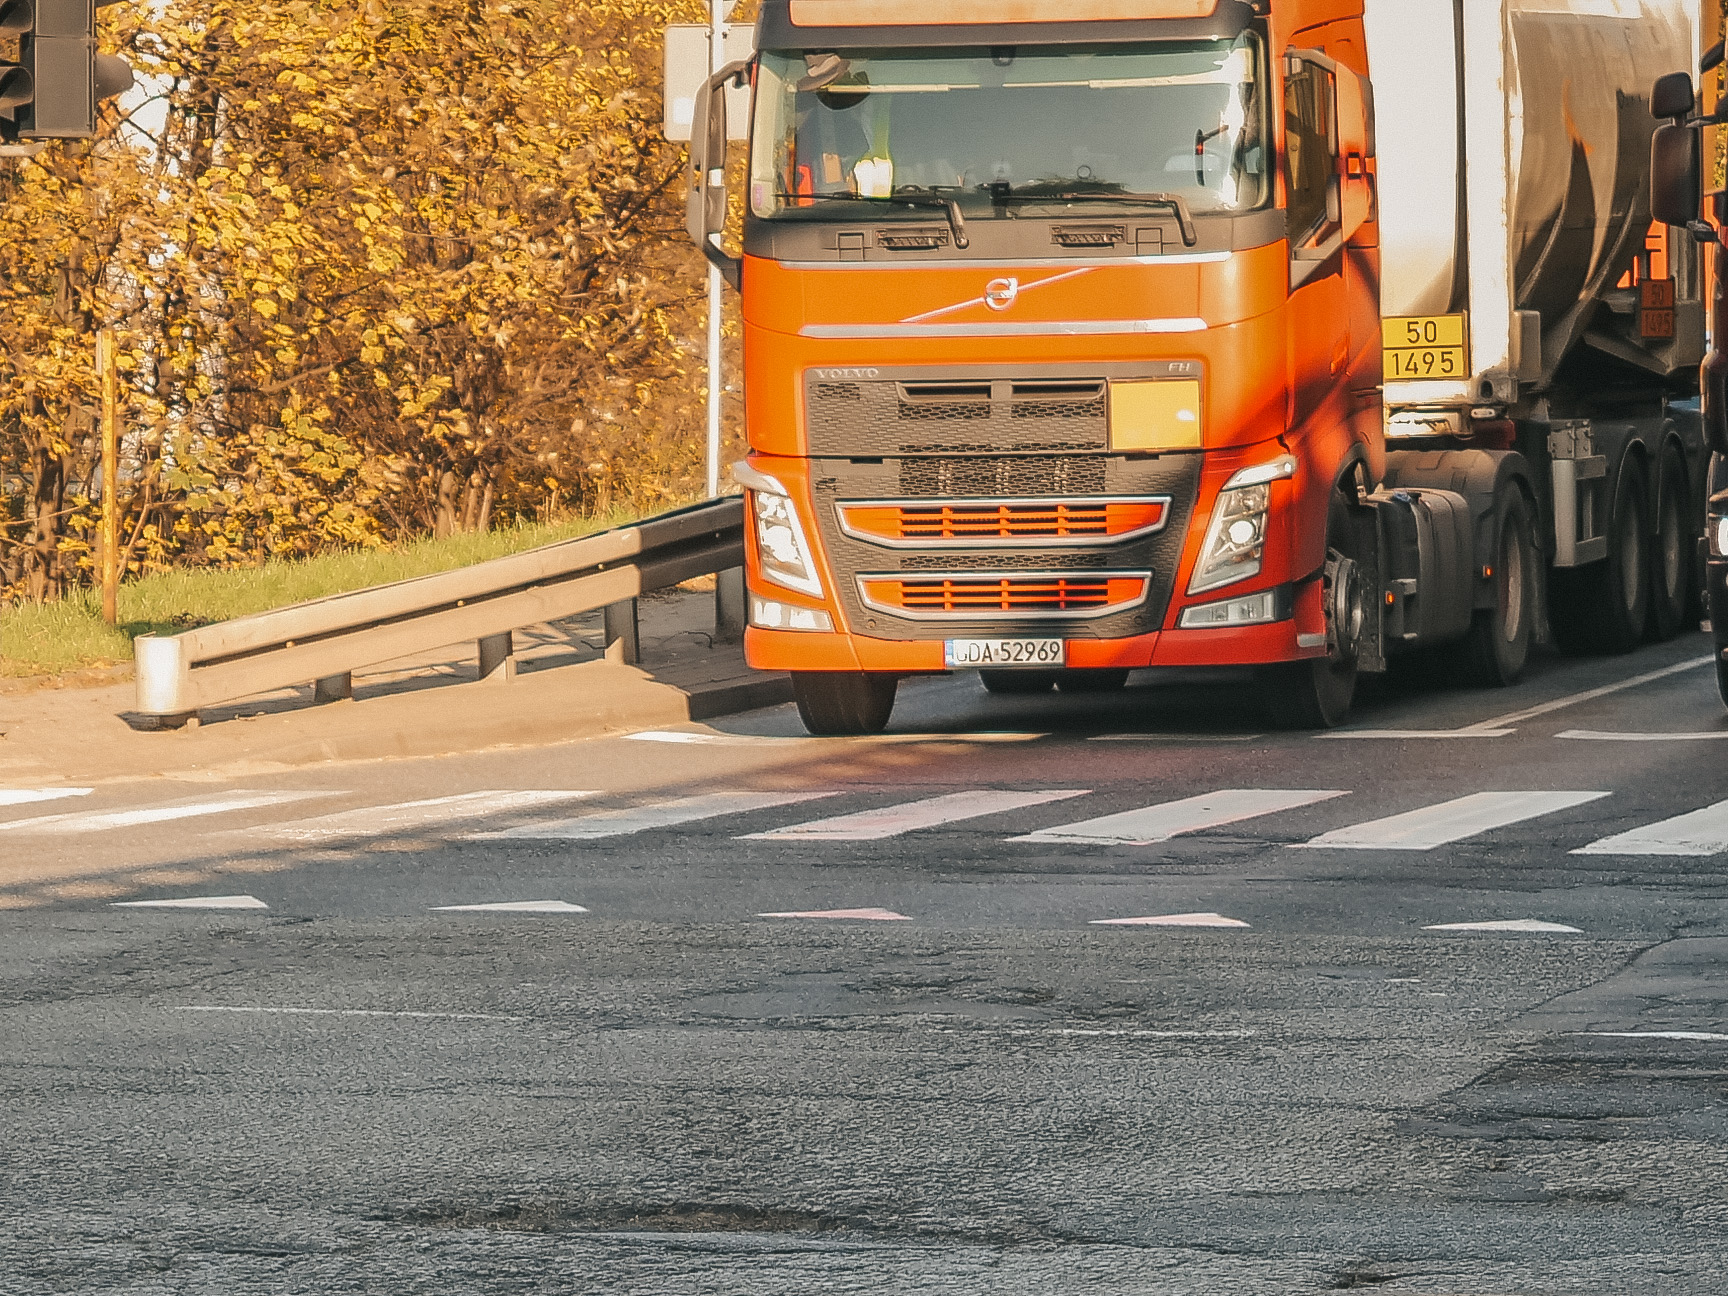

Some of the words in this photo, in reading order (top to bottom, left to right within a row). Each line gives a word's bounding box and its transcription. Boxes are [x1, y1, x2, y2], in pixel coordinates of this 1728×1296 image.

[1406, 320, 1437, 344] 50
[815, 368, 879, 379] VOLVO
[1168, 362, 1190, 372] FH
[1392, 351, 1454, 376] 1495
[1000, 641, 1060, 662] 52969
